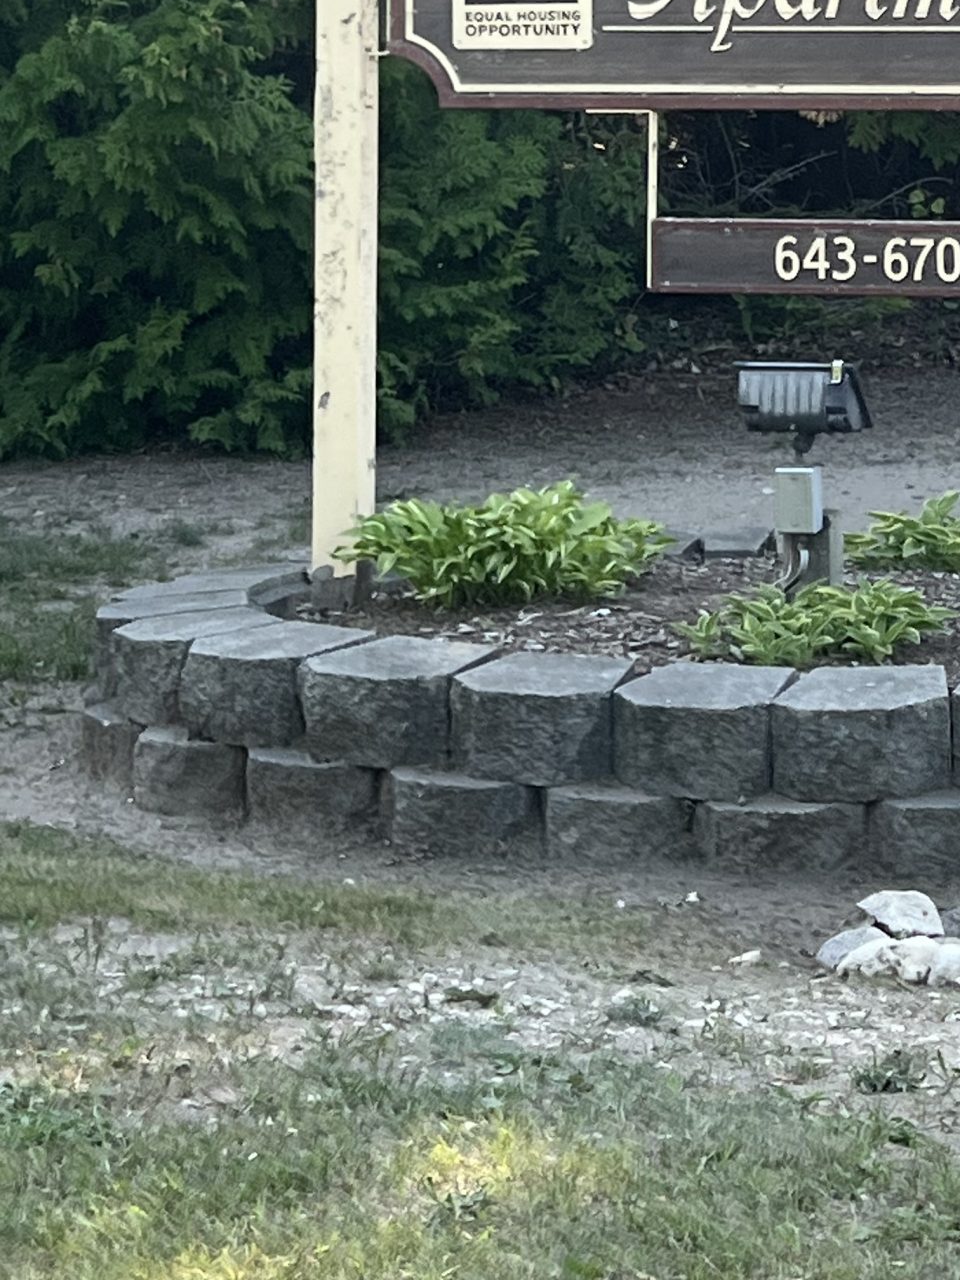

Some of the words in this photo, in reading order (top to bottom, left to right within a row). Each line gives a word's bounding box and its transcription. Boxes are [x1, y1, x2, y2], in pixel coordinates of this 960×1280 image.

[464, 11, 513, 23] EQUAL
[516, 10, 582, 22] HOUSING
[464, 23, 582, 37] OPPORTUNITY
